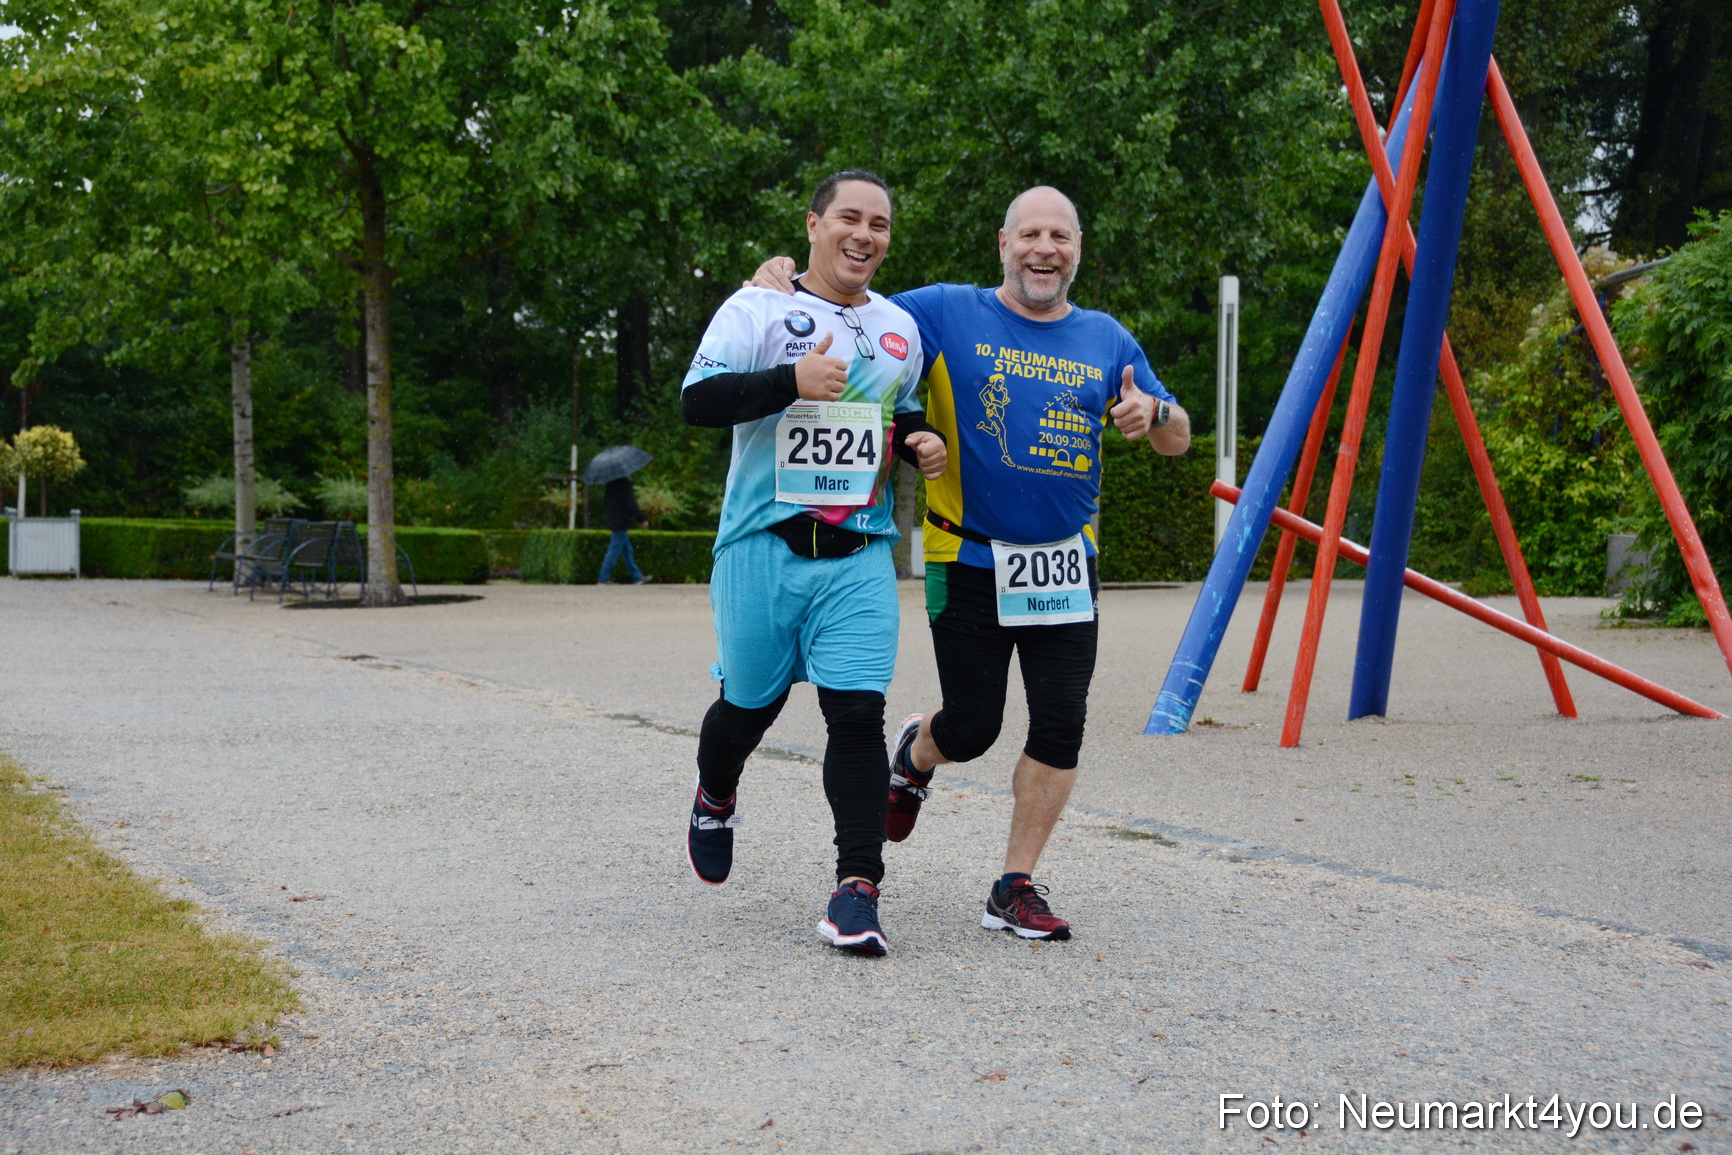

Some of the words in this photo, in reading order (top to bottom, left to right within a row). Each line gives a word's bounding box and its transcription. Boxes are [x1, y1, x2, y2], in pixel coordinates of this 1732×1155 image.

[785, 342, 817, 351] PART
[975, 343, 995, 357] 10.
[999, 346, 1103, 381] NEUMARKTER
[994, 359, 1085, 388] STADTLAUF
[827, 406, 874, 419] BOCK
[788, 427, 876, 466] 2524
[1038, 431, 1093, 451] 20.09.2009
[815, 476, 849, 490] Marc
[1007, 549, 1081, 588] 2038
[1027, 596, 1070, 612] Norbert
